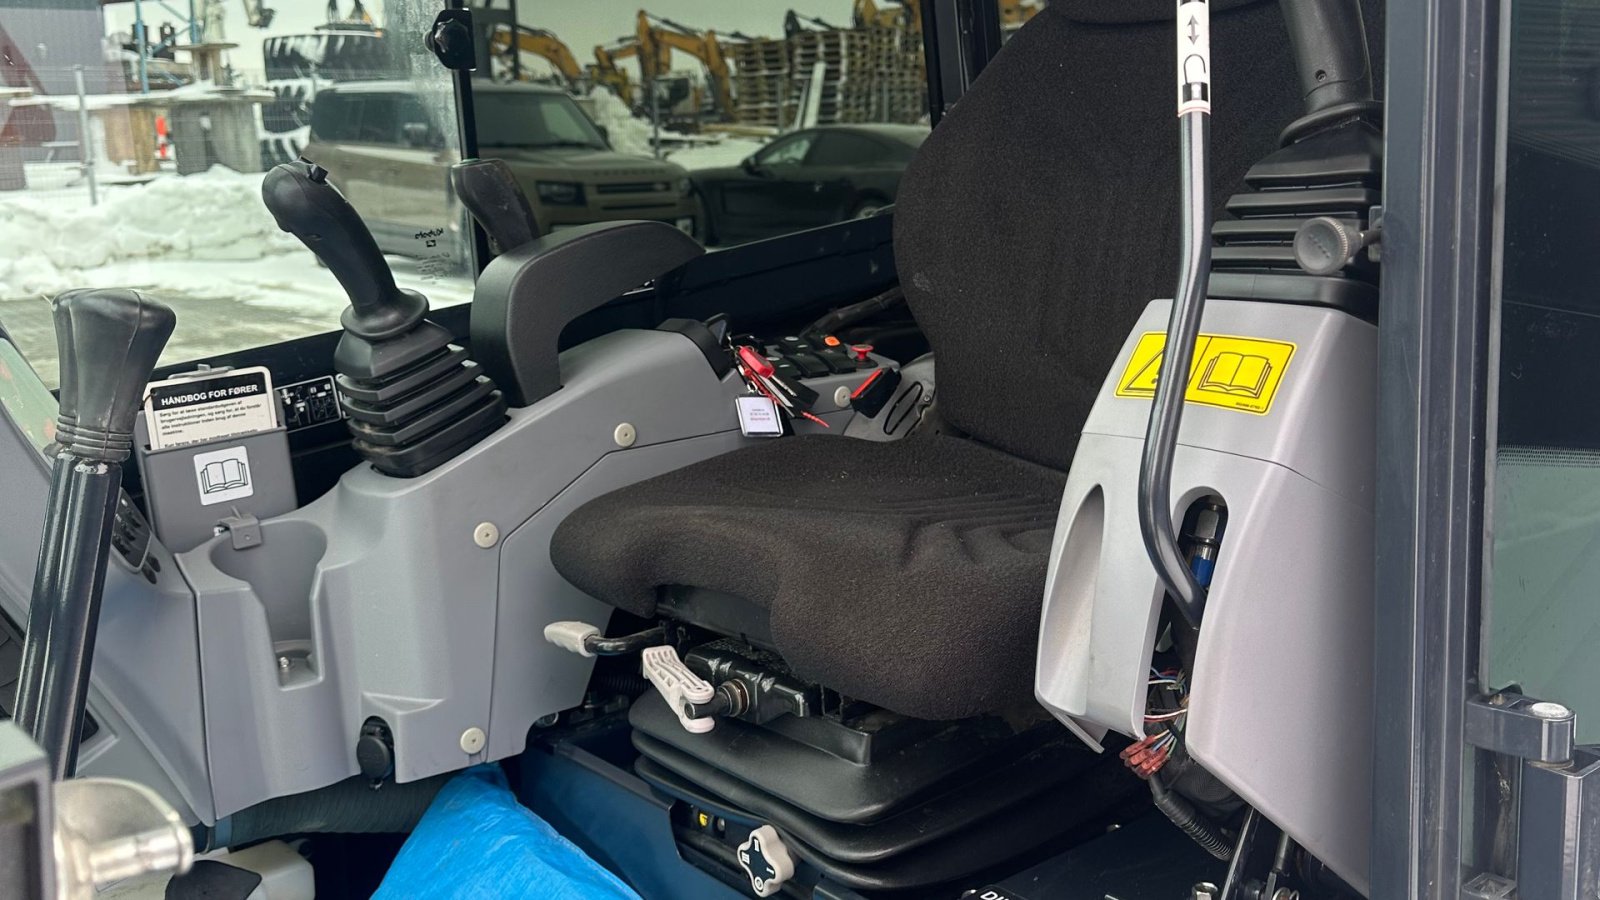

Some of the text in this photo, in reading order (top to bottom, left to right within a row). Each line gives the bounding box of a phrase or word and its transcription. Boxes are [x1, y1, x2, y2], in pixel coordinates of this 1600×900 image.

[161, 384, 258, 406] HÅNDBOG FOR FØRER
